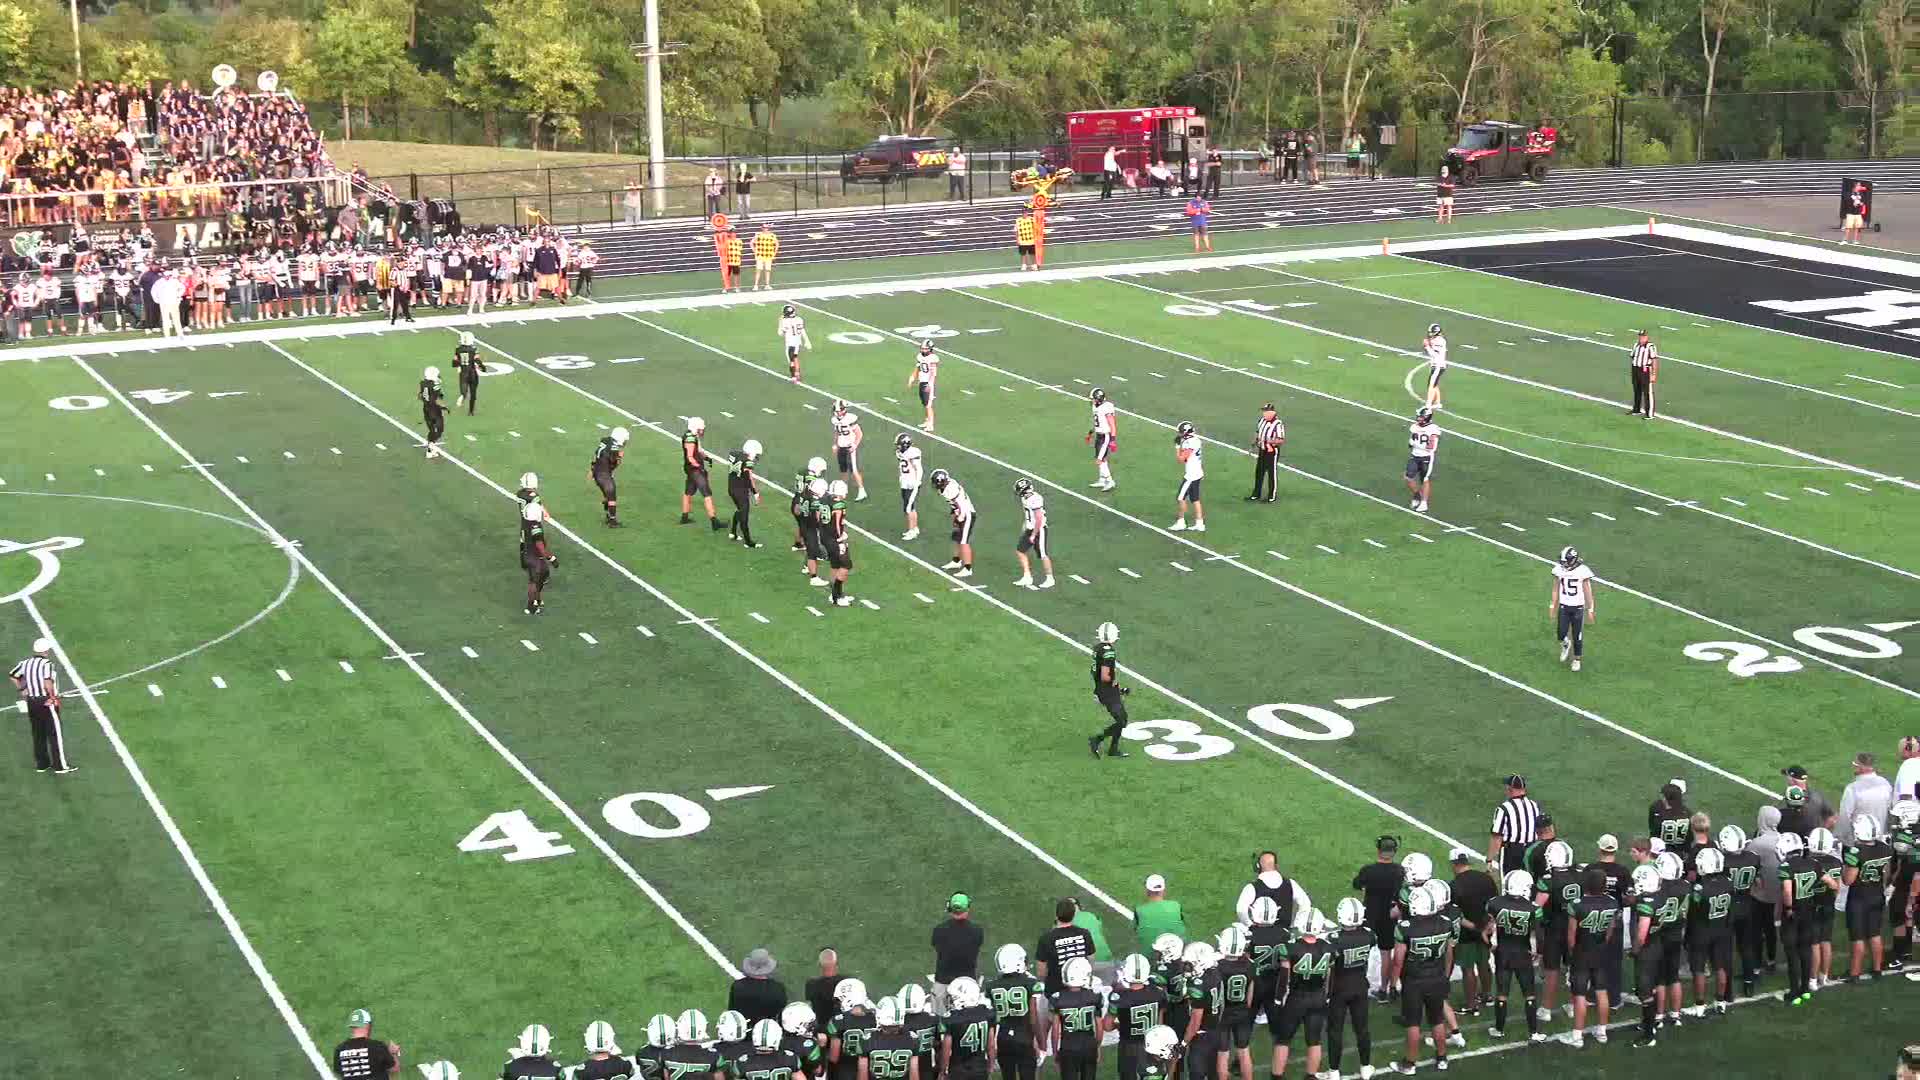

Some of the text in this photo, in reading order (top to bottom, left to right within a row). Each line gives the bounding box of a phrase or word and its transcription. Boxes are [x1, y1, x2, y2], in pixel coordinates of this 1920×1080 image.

[1560, 577, 1579, 597] 15
[1709, 893, 1731, 920] 19
[1496, 908, 1531, 936] 43
[1343, 945, 1371, 968] 15
[1410, 931, 1452, 961] 57
[1293, 952, 1331, 980] 44
[1227, 974, 1247, 1001] 8
[991, 986, 1029, 1018] 89
[1060, 1006, 1096, 1033] 30
[1130, 1002, 1159, 1036] 51
[960, 1021, 988, 1051] 41
